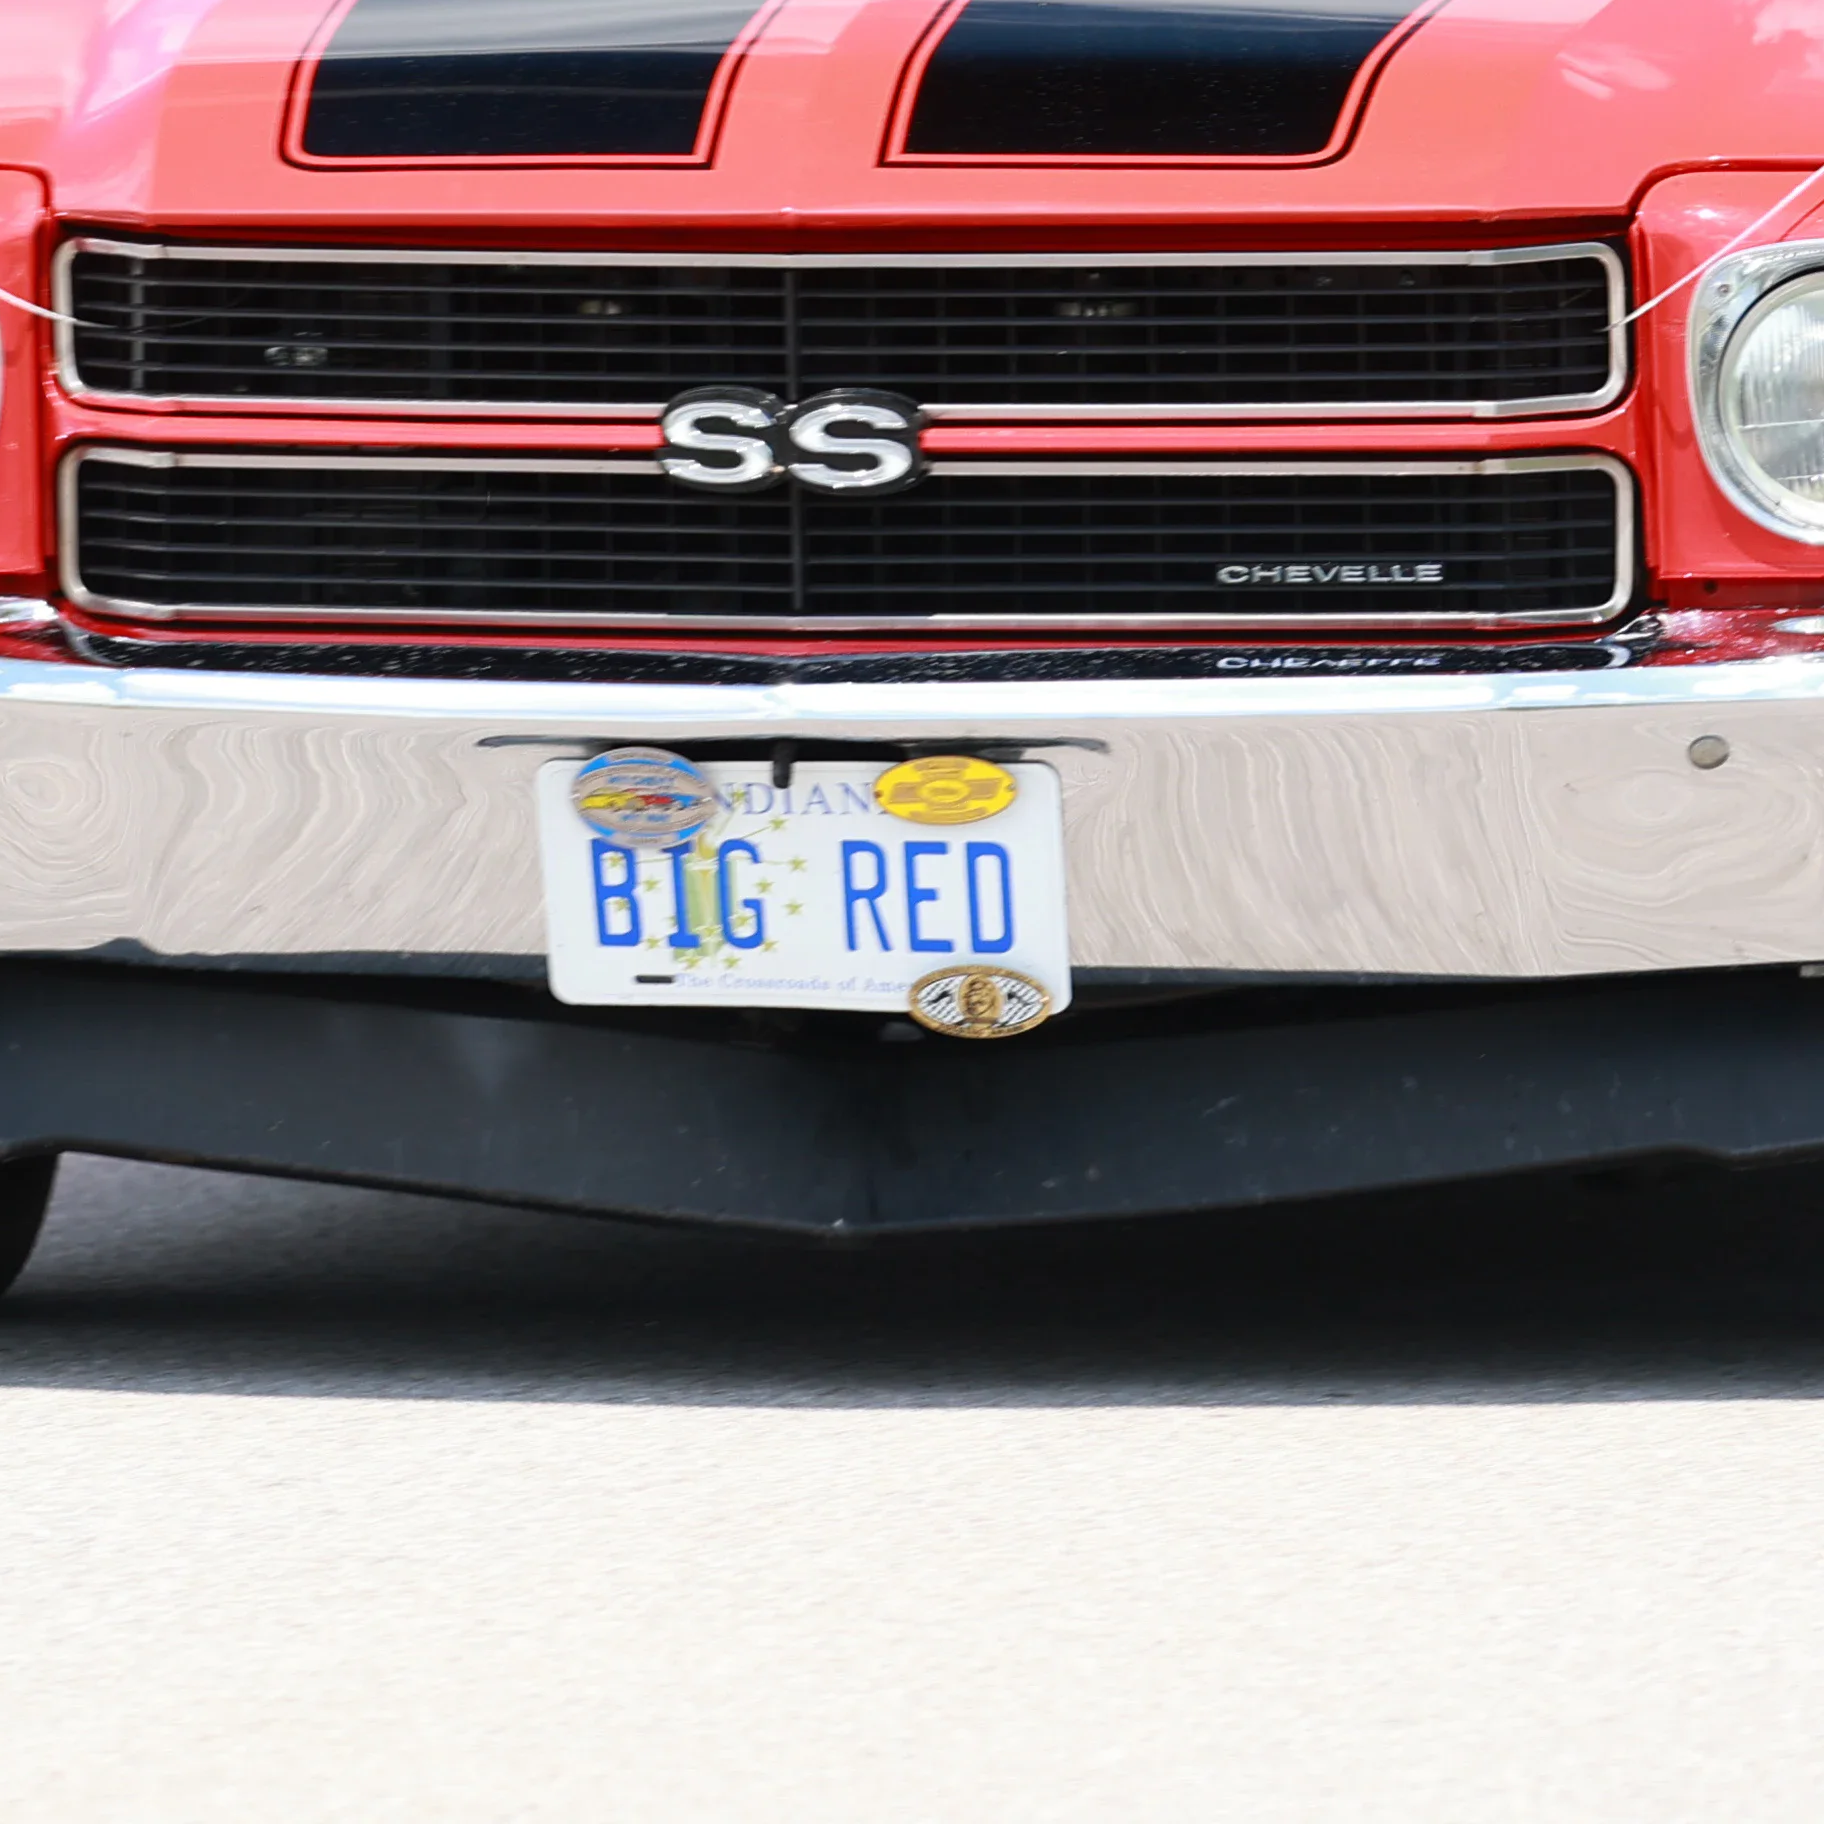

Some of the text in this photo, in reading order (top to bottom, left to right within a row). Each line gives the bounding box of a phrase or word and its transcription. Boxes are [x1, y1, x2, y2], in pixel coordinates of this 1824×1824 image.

[662, 399, 913, 488] SS
[1216, 564, 1444, 583] CHEVELLE
[713, 782, 889, 815] NDIAN
[591, 838, 1014, 953] BIG RED
